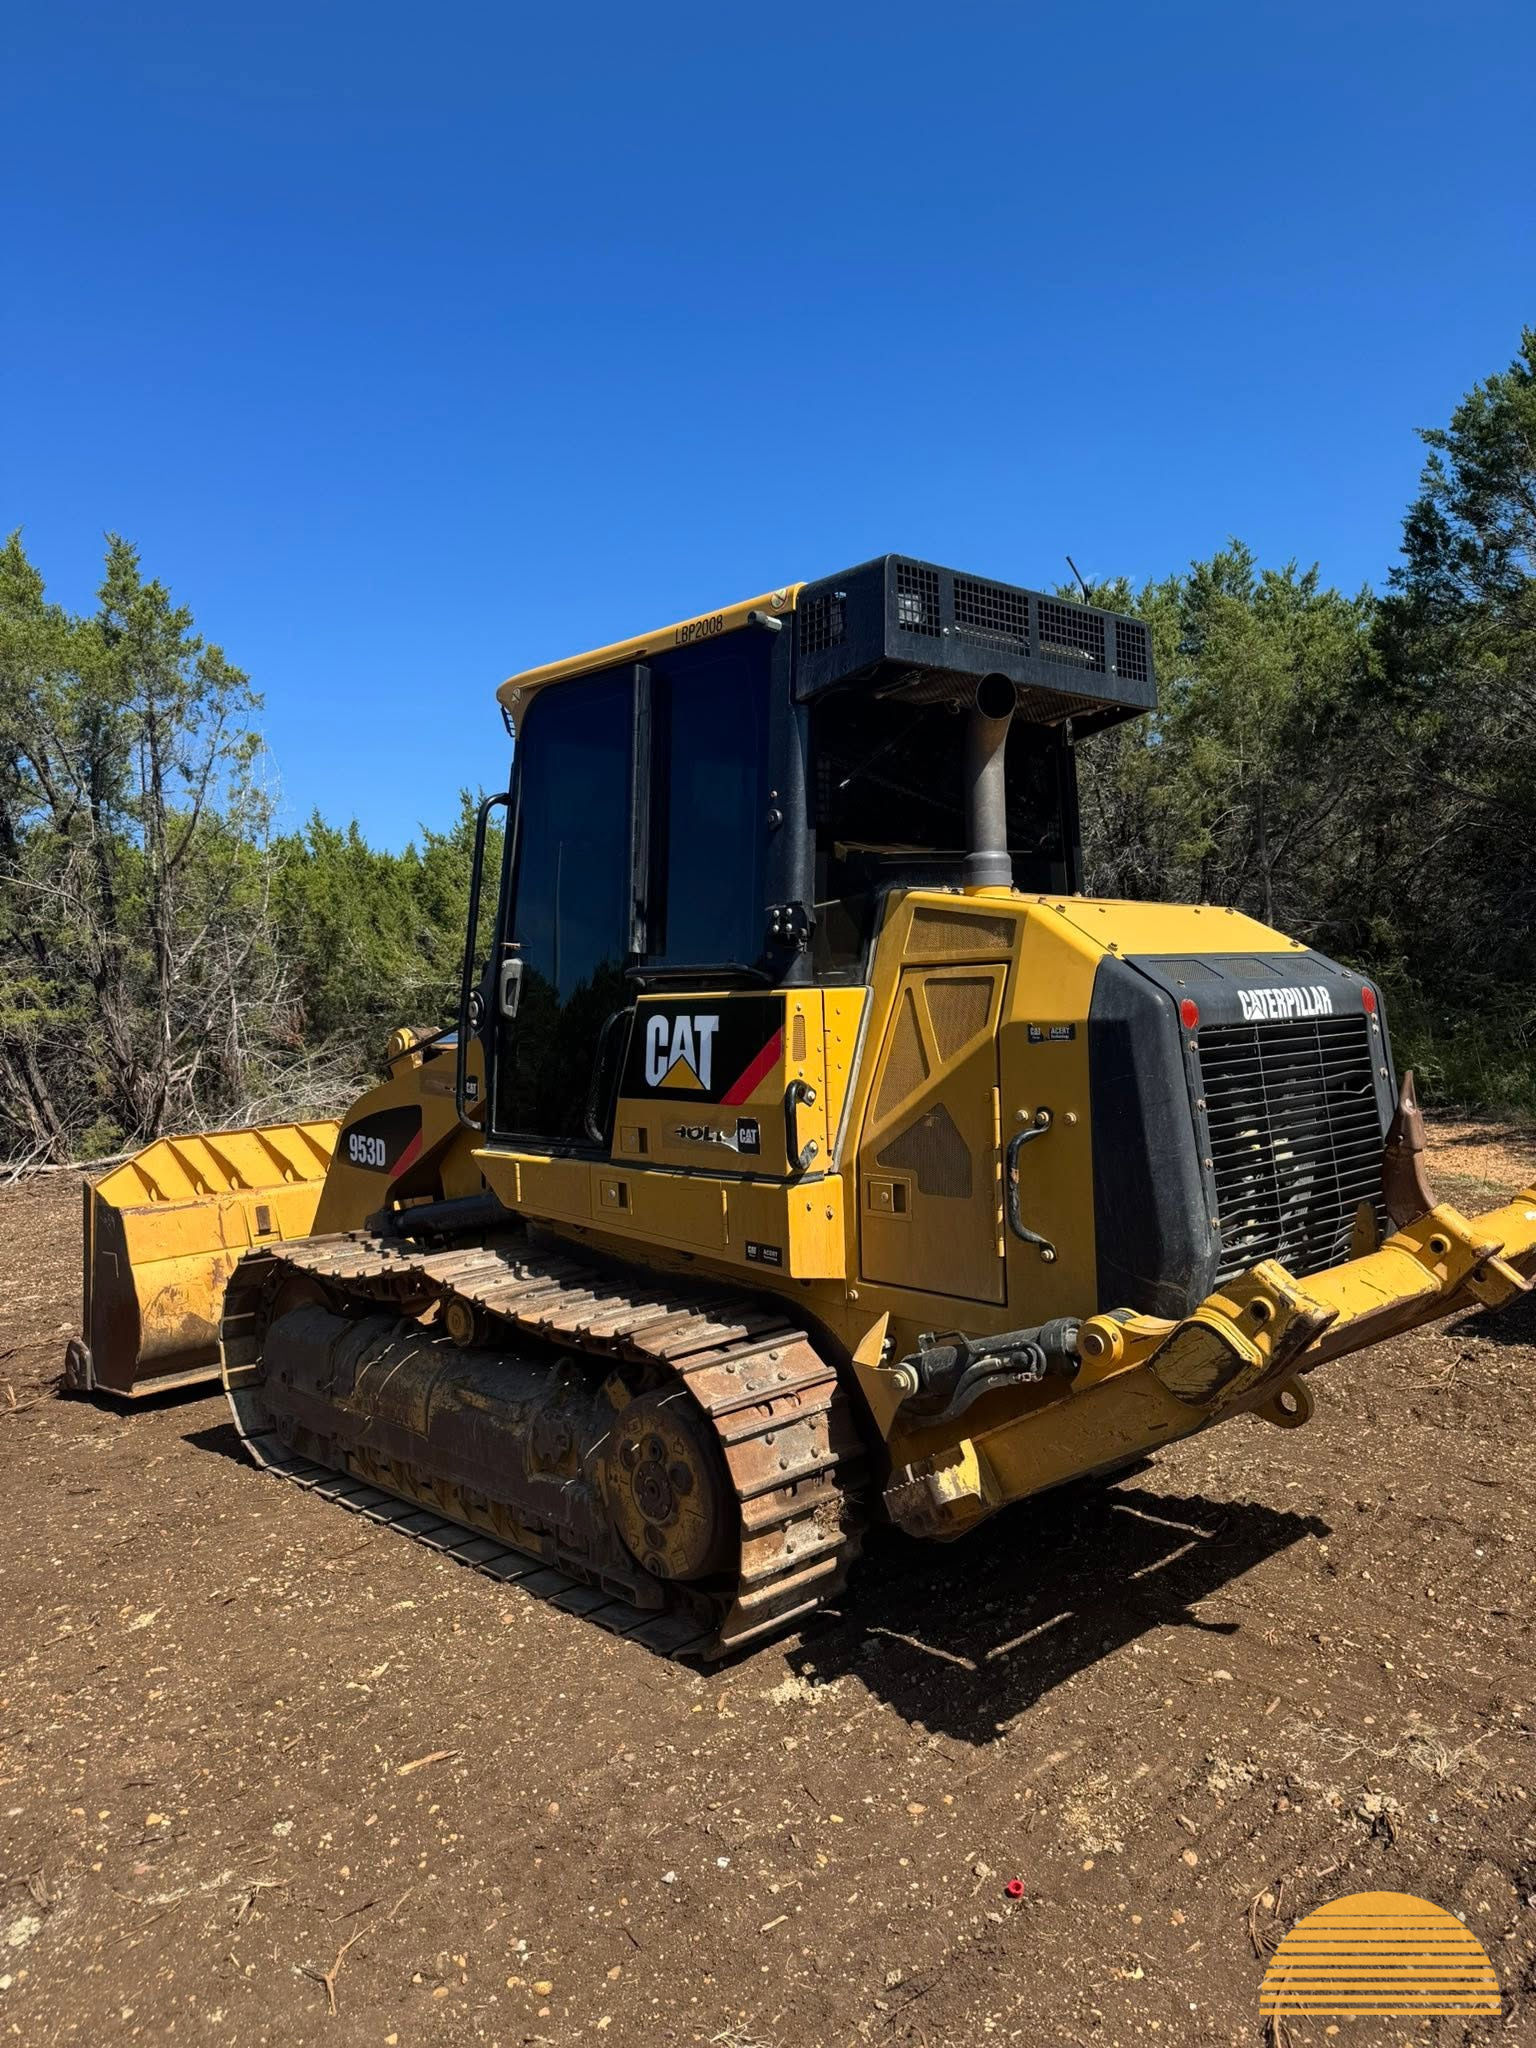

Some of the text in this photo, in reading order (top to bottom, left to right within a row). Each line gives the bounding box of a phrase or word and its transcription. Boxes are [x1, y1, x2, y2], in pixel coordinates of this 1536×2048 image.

[675, 615, 723, 645] LBP2008
[1237, 986, 1333, 1020] CATERPILLAR
[645, 1015, 719, 1090] CAT
[466, 1082, 477, 1094] CAT
[350, 1134, 386, 1166] 953D
[740, 1128, 757, 1144] CAT
